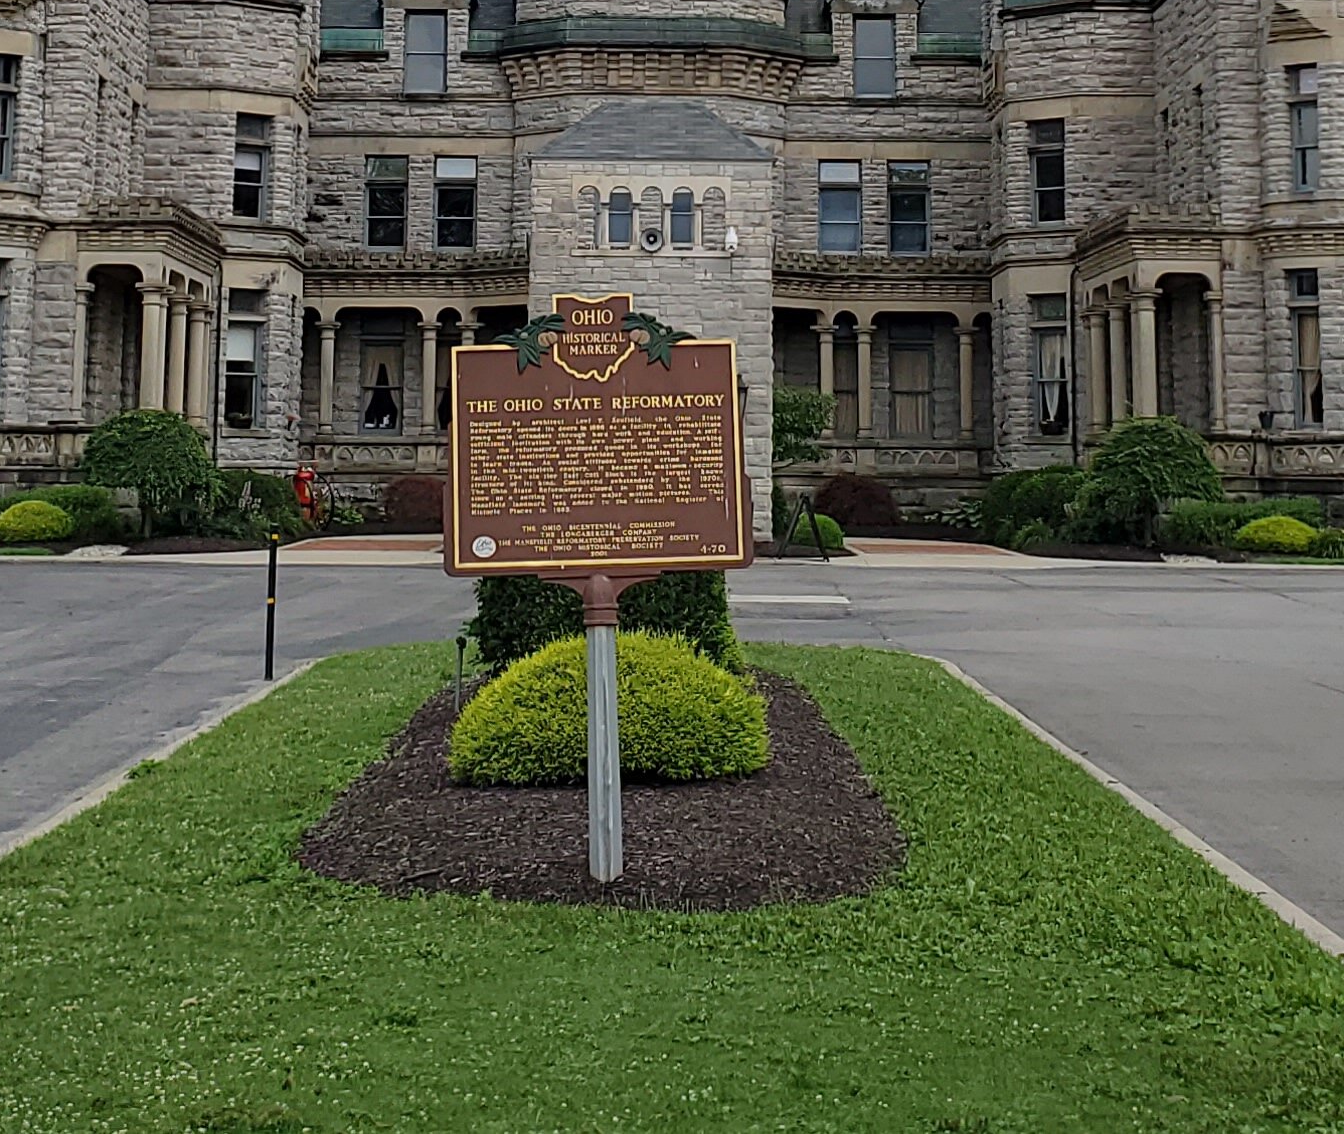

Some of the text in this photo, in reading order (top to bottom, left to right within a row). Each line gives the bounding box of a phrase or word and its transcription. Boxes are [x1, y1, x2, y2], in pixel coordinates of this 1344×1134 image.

[571, 309, 613, 326] OHIO
[562, 331, 626, 344] HISTORICAL
[569, 344, 619, 356] MARKER
[466, 393, 725, 414] THE OHIO STATE REFORMATORY
